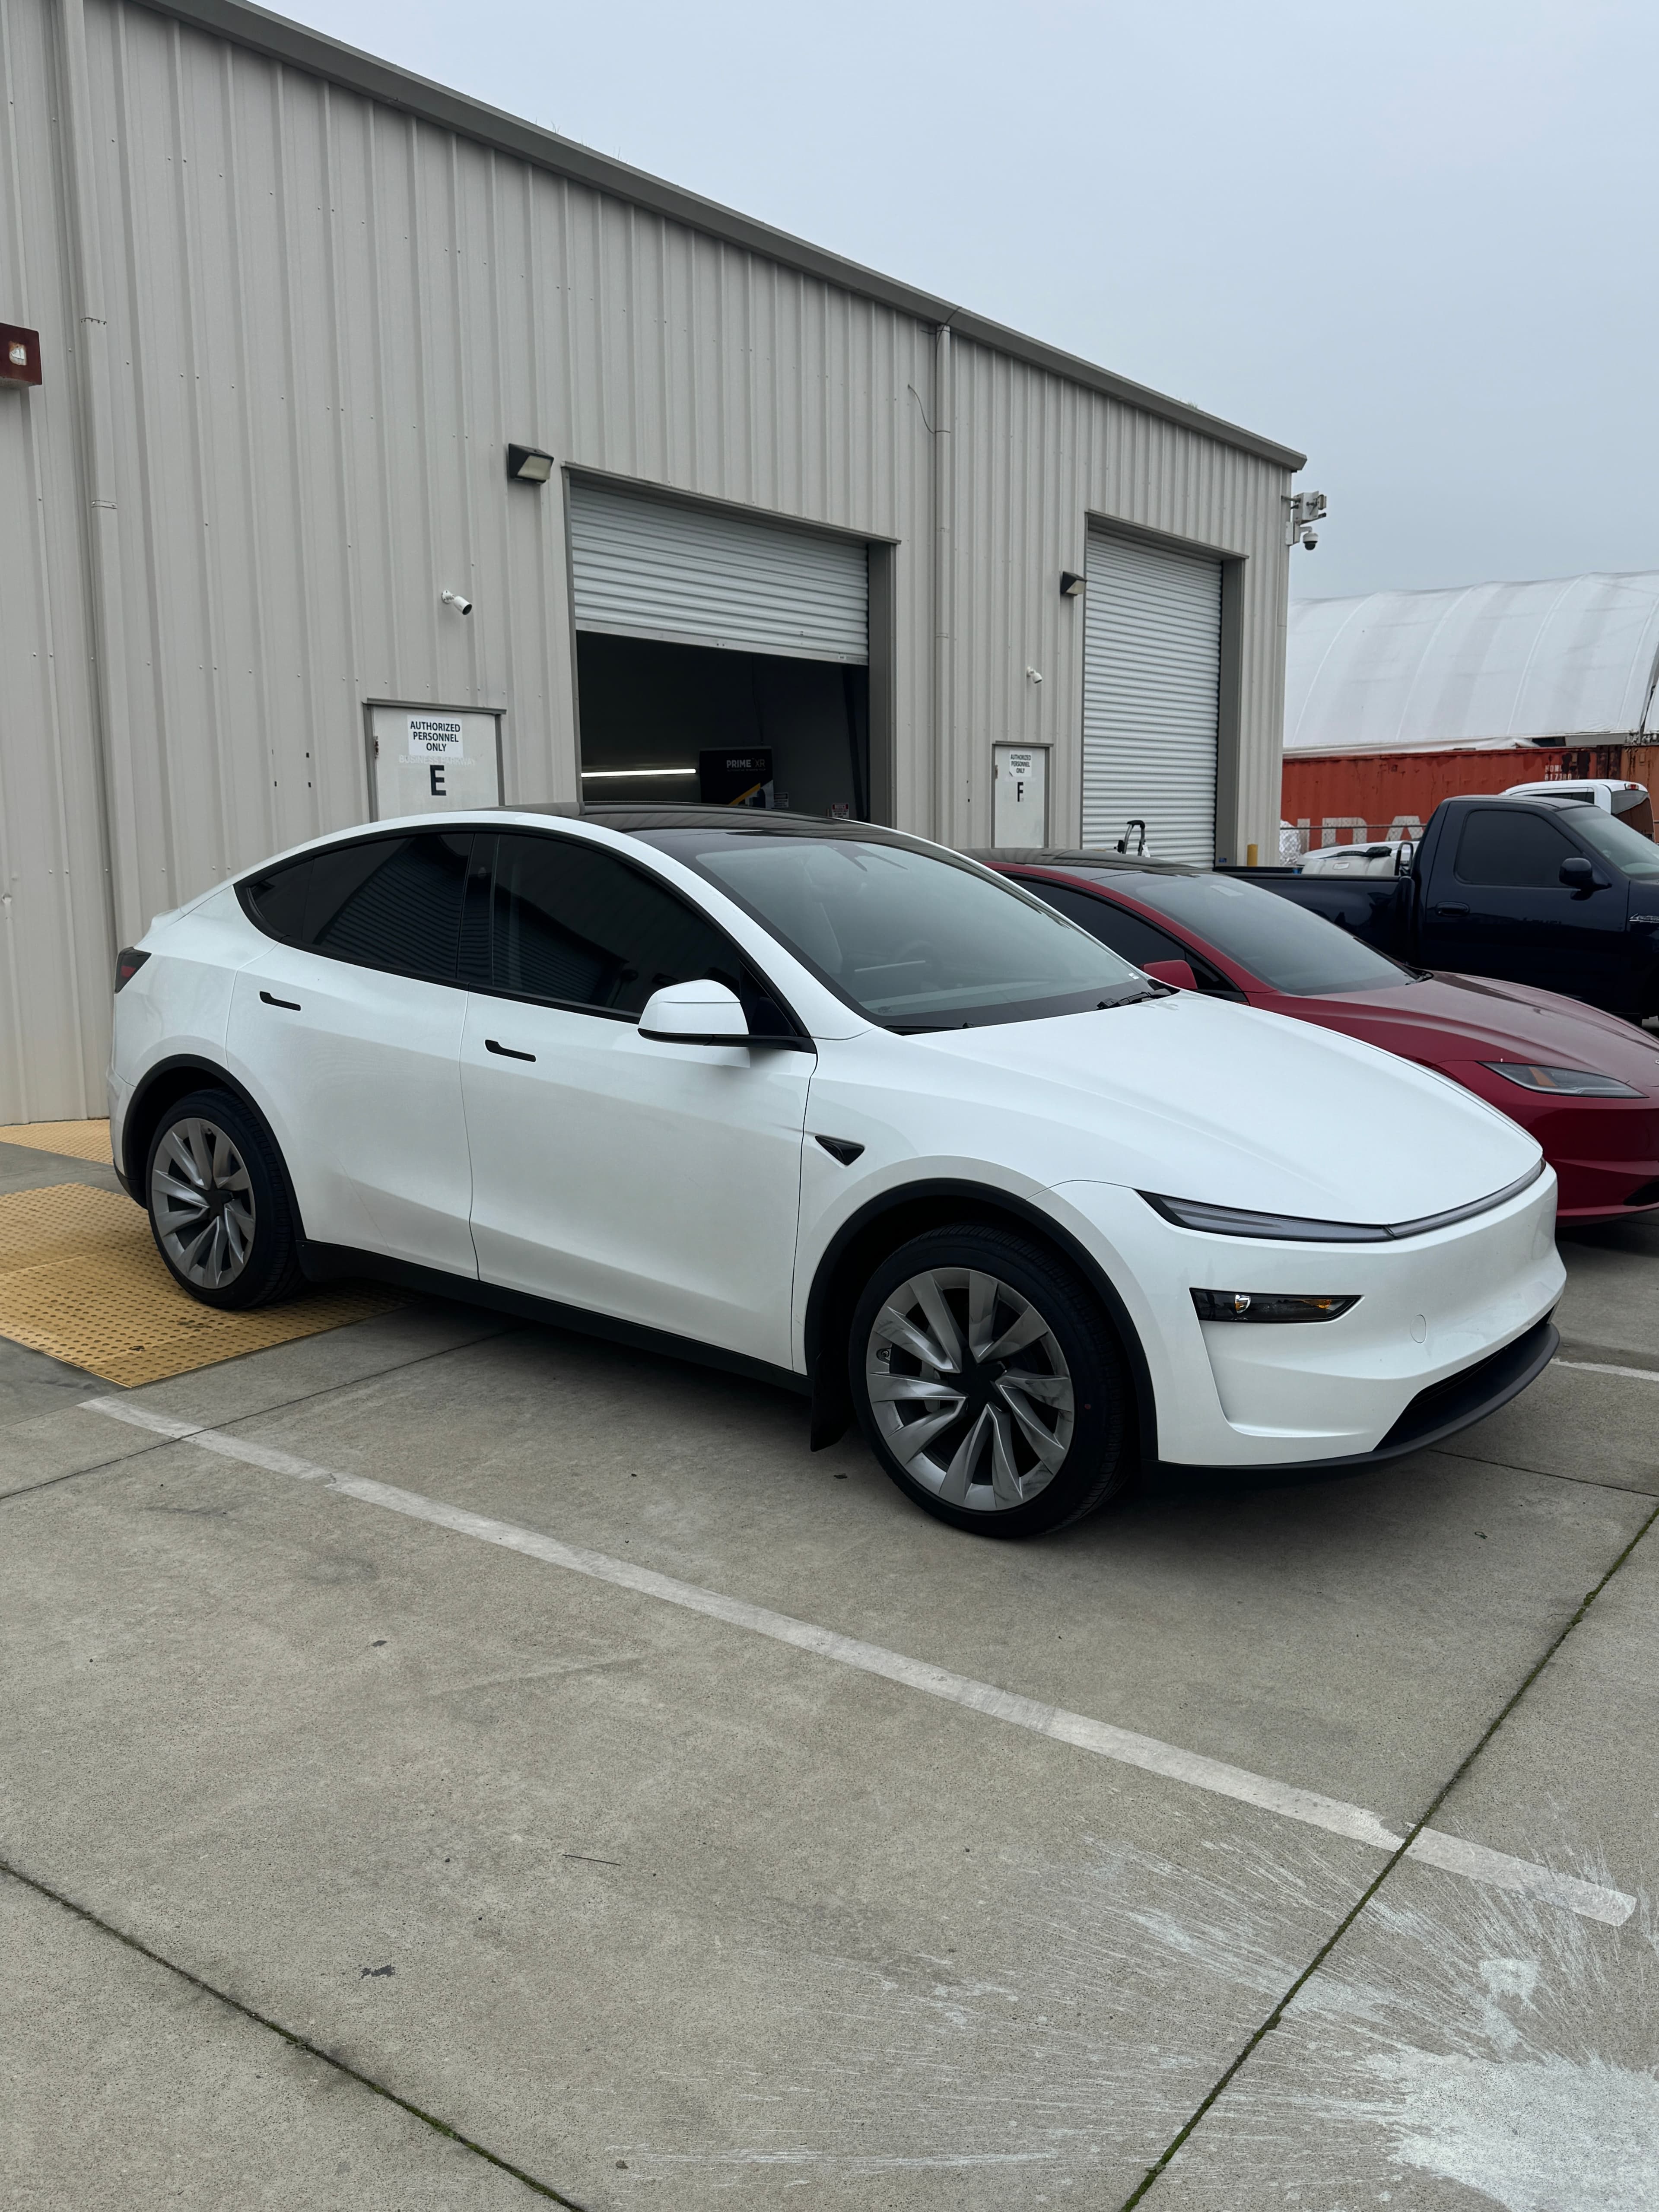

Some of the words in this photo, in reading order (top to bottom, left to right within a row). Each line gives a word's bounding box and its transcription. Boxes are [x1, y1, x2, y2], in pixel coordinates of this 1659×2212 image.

[410, 721, 461, 732] AUTHORIZED
[413, 731, 459, 742] PERSONNEL
[426, 742, 447, 752] ONLY
[726, 759, 752, 768] PRIME
[755, 759, 765, 768] XR
[429, 764, 447, 796] E
[1017, 782, 1023, 802] F
